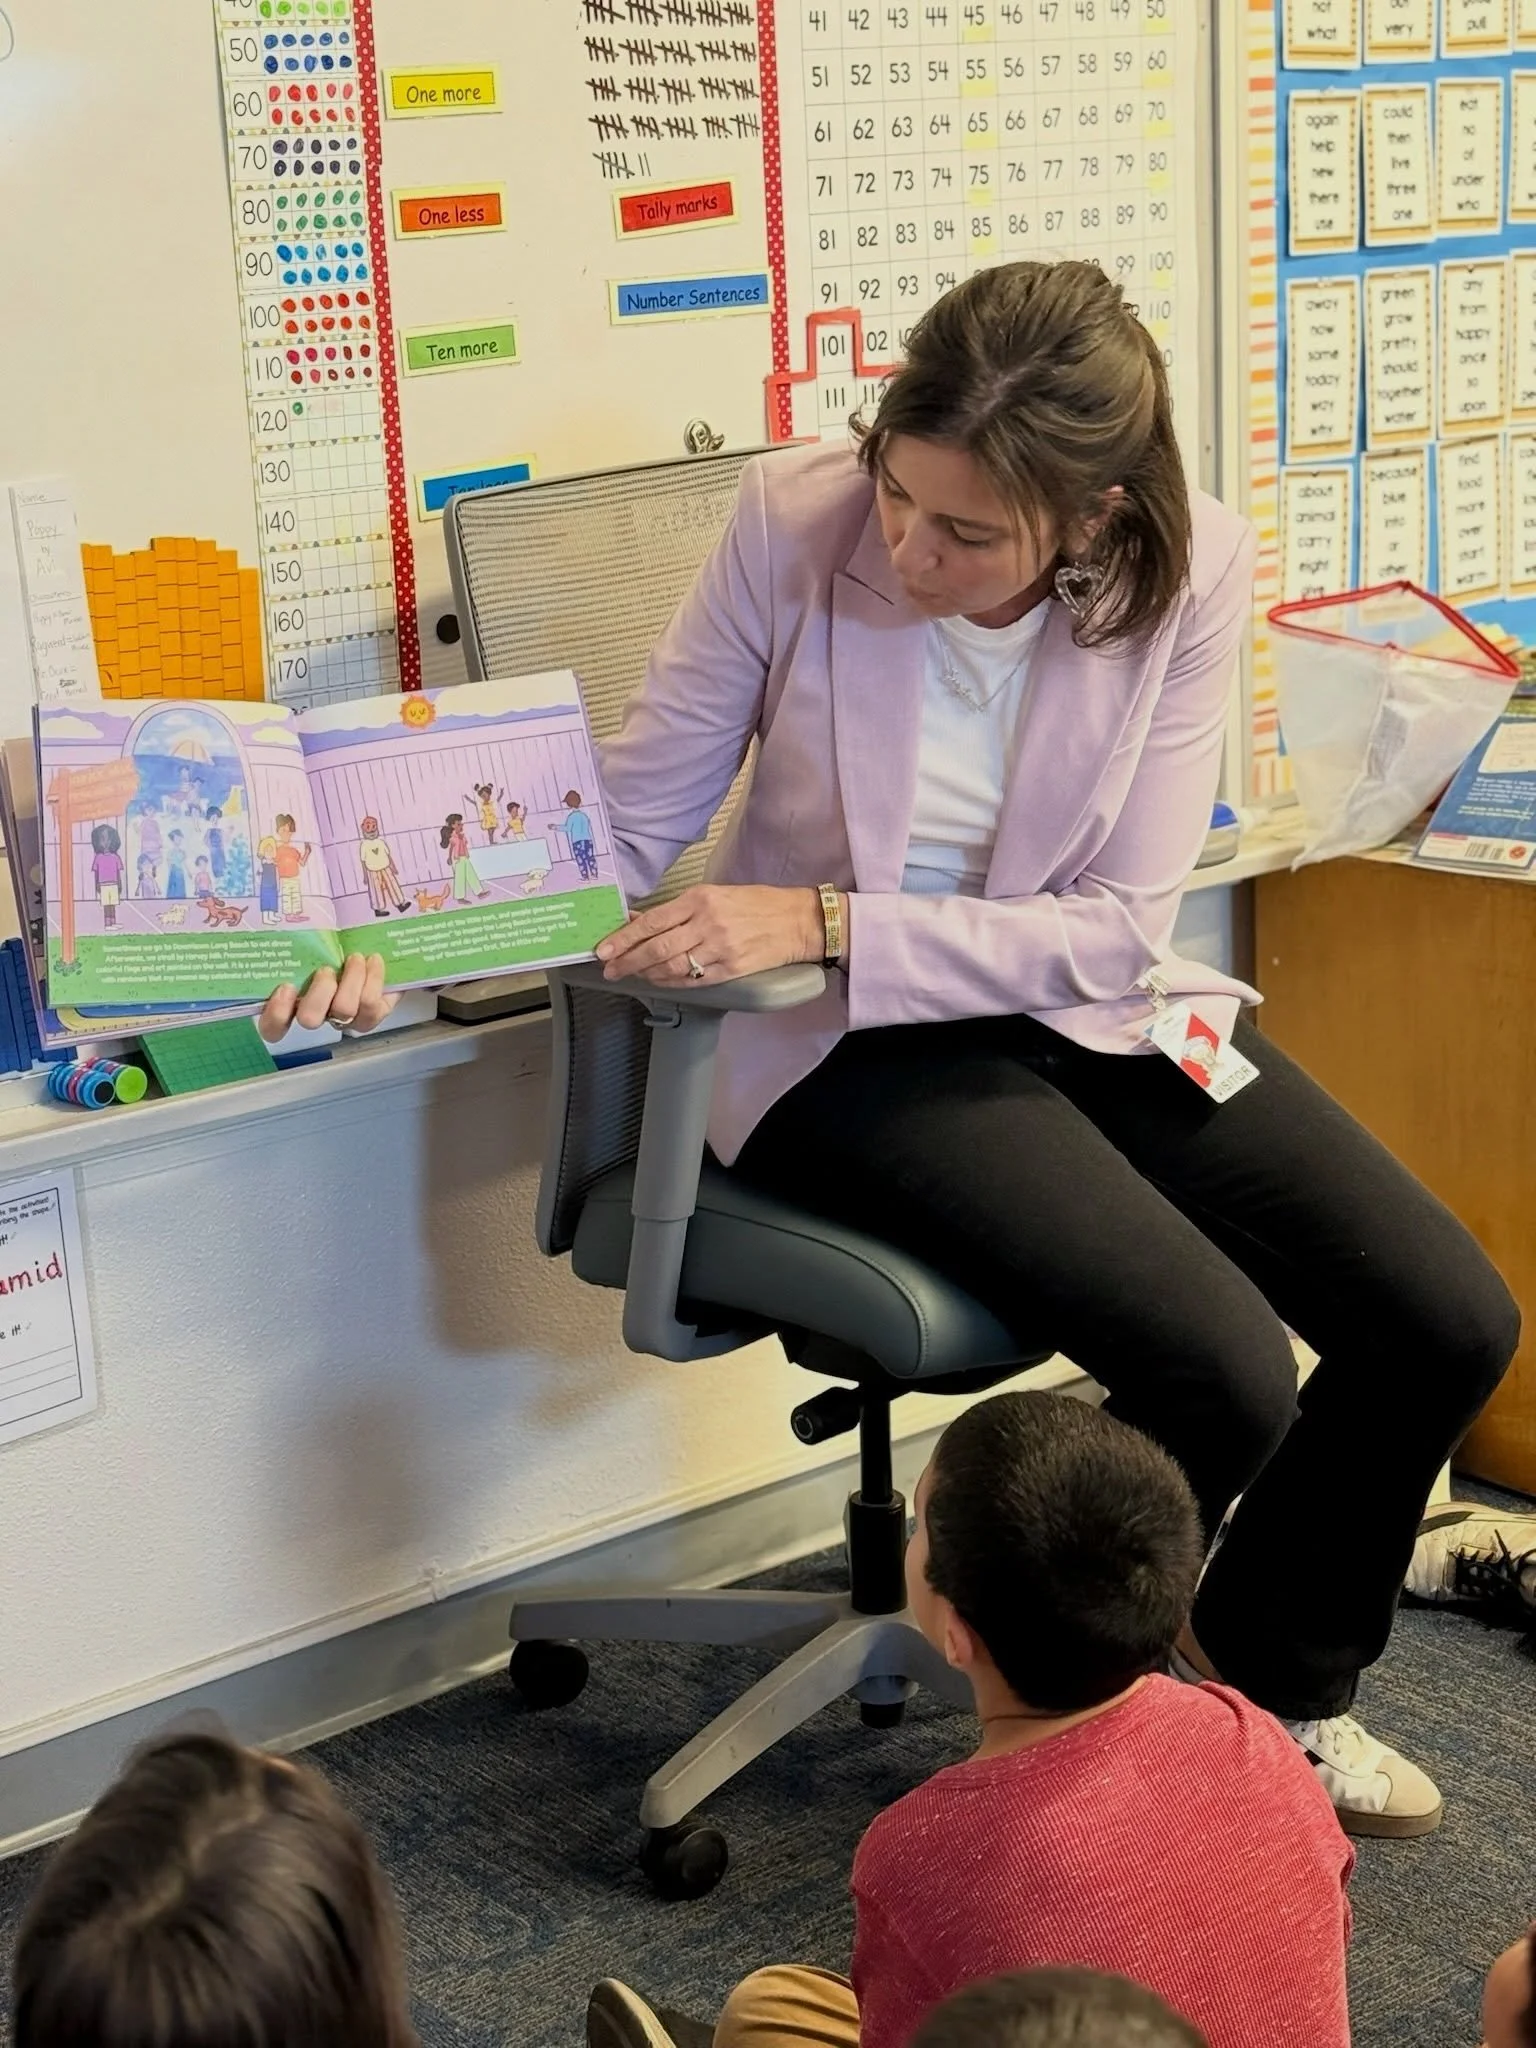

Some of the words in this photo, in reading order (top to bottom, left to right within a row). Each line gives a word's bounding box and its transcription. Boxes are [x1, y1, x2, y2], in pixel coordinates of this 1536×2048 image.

[809, 11, 826, 31] 41
[849, 9, 869, 30] 42
[888, 8, 908, 28] 43
[926, 7, 947, 26] 44
[964, 5, 984, 25] 45
[1001, 5, 1022, 24] 46
[1040, 2, 1058, 21] 47
[1075, 1, 1094, 21] 48
[1111, 0, 1130, 17] 49
[1147, 0, 1164, 18] 50
[1385, 23, 1413, 35] very
[1467, 15, 1487, 32] pull
[1307, 27, 1337, 41] what
[230, 38, 257, 62] 50
[813, 66, 828, 87] 51
[851, 64, 871, 85] 52
[890, 62, 910, 83] 53
[929, 61, 948, 81] 54
[967, 59, 986, 79] 55
[1004, 58, 1024, 77] 56
[1042, 56, 1060, 76] 57
[1078, 54, 1096, 73] 58
[1115, 52, 1132, 72] 59
[1148, 50, 1166, 70] 60
[407, 86, 437, 103] One
[443, 88, 481, 102] more
[233, 92, 262, 116] 60
[1459, 99, 1479, 111] eat
[1383, 105, 1413, 120] could
[815, 121, 830, 142] 61
[853, 119, 874, 140] 62
[892, 116, 912, 137] 63
[930, 115, 950, 135] 64
[968, 112, 988, 132] 65
[1006, 111, 1025, 130] 66
[1043, 108, 1061, 128] 67
[1079, 105, 1098, 125] 68
[1115, 104, 1132, 123] 69
[1148, 101, 1164, 120] 70
[1305, 114, 1339, 130] again
[1387, 132, 1411, 144] then
[1311, 140, 1334, 154] help
[239, 145, 267, 170] 70
[816, 176, 832, 196] 71
[855, 172, 875, 193] 72
[893, 170, 913, 190] 73
[931, 168, 952, 188] 74
[969, 165, 989, 184] 75
[1008, 163, 1025, 181] 76
[1044, 160, 1062, 179] 77
[1080, 157, 1098, 176] 78
[1116, 154, 1134, 173] 79
[1149, 152, 1166, 171] 80
[1312, 167, 1334, 178] new
[1452, 175, 1484, 186] under
[1386, 183, 1417, 195] three
[1309, 192, 1340, 203] there
[1457, 199, 1479, 211] who
[243, 199, 270, 225] 80
[419, 208, 450, 225] One
[456, 205, 484, 223] less
[637, 201, 671, 222] Tally
[676, 195, 717, 214] marks
[1393, 209, 1413, 221] one
[819, 230, 835, 250] 81
[858, 226, 878, 247] 82
[896, 223, 916, 244] 83
[934, 220, 954, 240] 84
[972, 217, 991, 237] 85
[1009, 214, 1028, 234] 86
[1045, 211, 1063, 231] 87
[1081, 208, 1100, 228] 88
[1117, 205, 1134, 224] 89
[1150, 202, 1167, 221] 90
[246, 252, 272, 276] 90
[821, 283, 837, 303] 91
[859, 279, 880, 300] 92
[898, 275, 918, 296] 93
[935, 273, 956, 292] 94
[1116, 255, 1135, 274] 99
[1151, 251, 1173, 271] 100
[628, 291, 684, 310] Number
[689, 288, 759, 305] Sentences
[1381, 288, 1415, 305] green
[1306, 299, 1338, 312] away
[1459, 303, 1487, 315] from
[250, 305, 280, 329] 100
[1384, 314, 1413, 329] grow
[822, 335, 844, 356] 101
[1150, 301, 1171, 319] 110
[1455, 328, 1491, 341] happy
[426, 345, 455, 361] Ten
[460, 342, 498, 358] more
[1381, 336, 1417, 352] pretty
[1308, 349, 1339, 361] some
[1460, 352, 1487, 365] once
[256, 357, 282, 380] 110
[1382, 361, 1418, 375] should
[1305, 374, 1340, 387] today
[826, 388, 844, 408] 111
[1377, 386, 1423, 402] together
[1311, 400, 1334, 411] way
[1459, 401, 1487, 414] upon
[256, 410, 287, 432] 120
[1384, 411, 1417, 424] water
[1310, 424, 1333, 436] why
[1458, 453, 1480, 466] find
[260, 460, 290, 484] 130
[1370, 466, 1418, 482] because
[1457, 476, 1483, 490] food
[1298, 485, 1334, 499] about
[1383, 492, 1407, 505] blue
[1456, 500, 1486, 513] more
[265, 511, 295, 534] 140
[1295, 511, 1336, 524] animal
[1384, 517, 1405, 529] into
[1459, 526, 1481, 538] over
[1298, 536, 1332, 548] carry
[271, 560, 301, 584] 150
[1298, 559, 1329, 575] eight
[1379, 564, 1407, 577] other
[1456, 571, 1487, 585] warm
[274, 609, 303, 633] 160
[279, 658, 308, 680] 170
[1212, 1065, 1251, 1096] VISITOR
